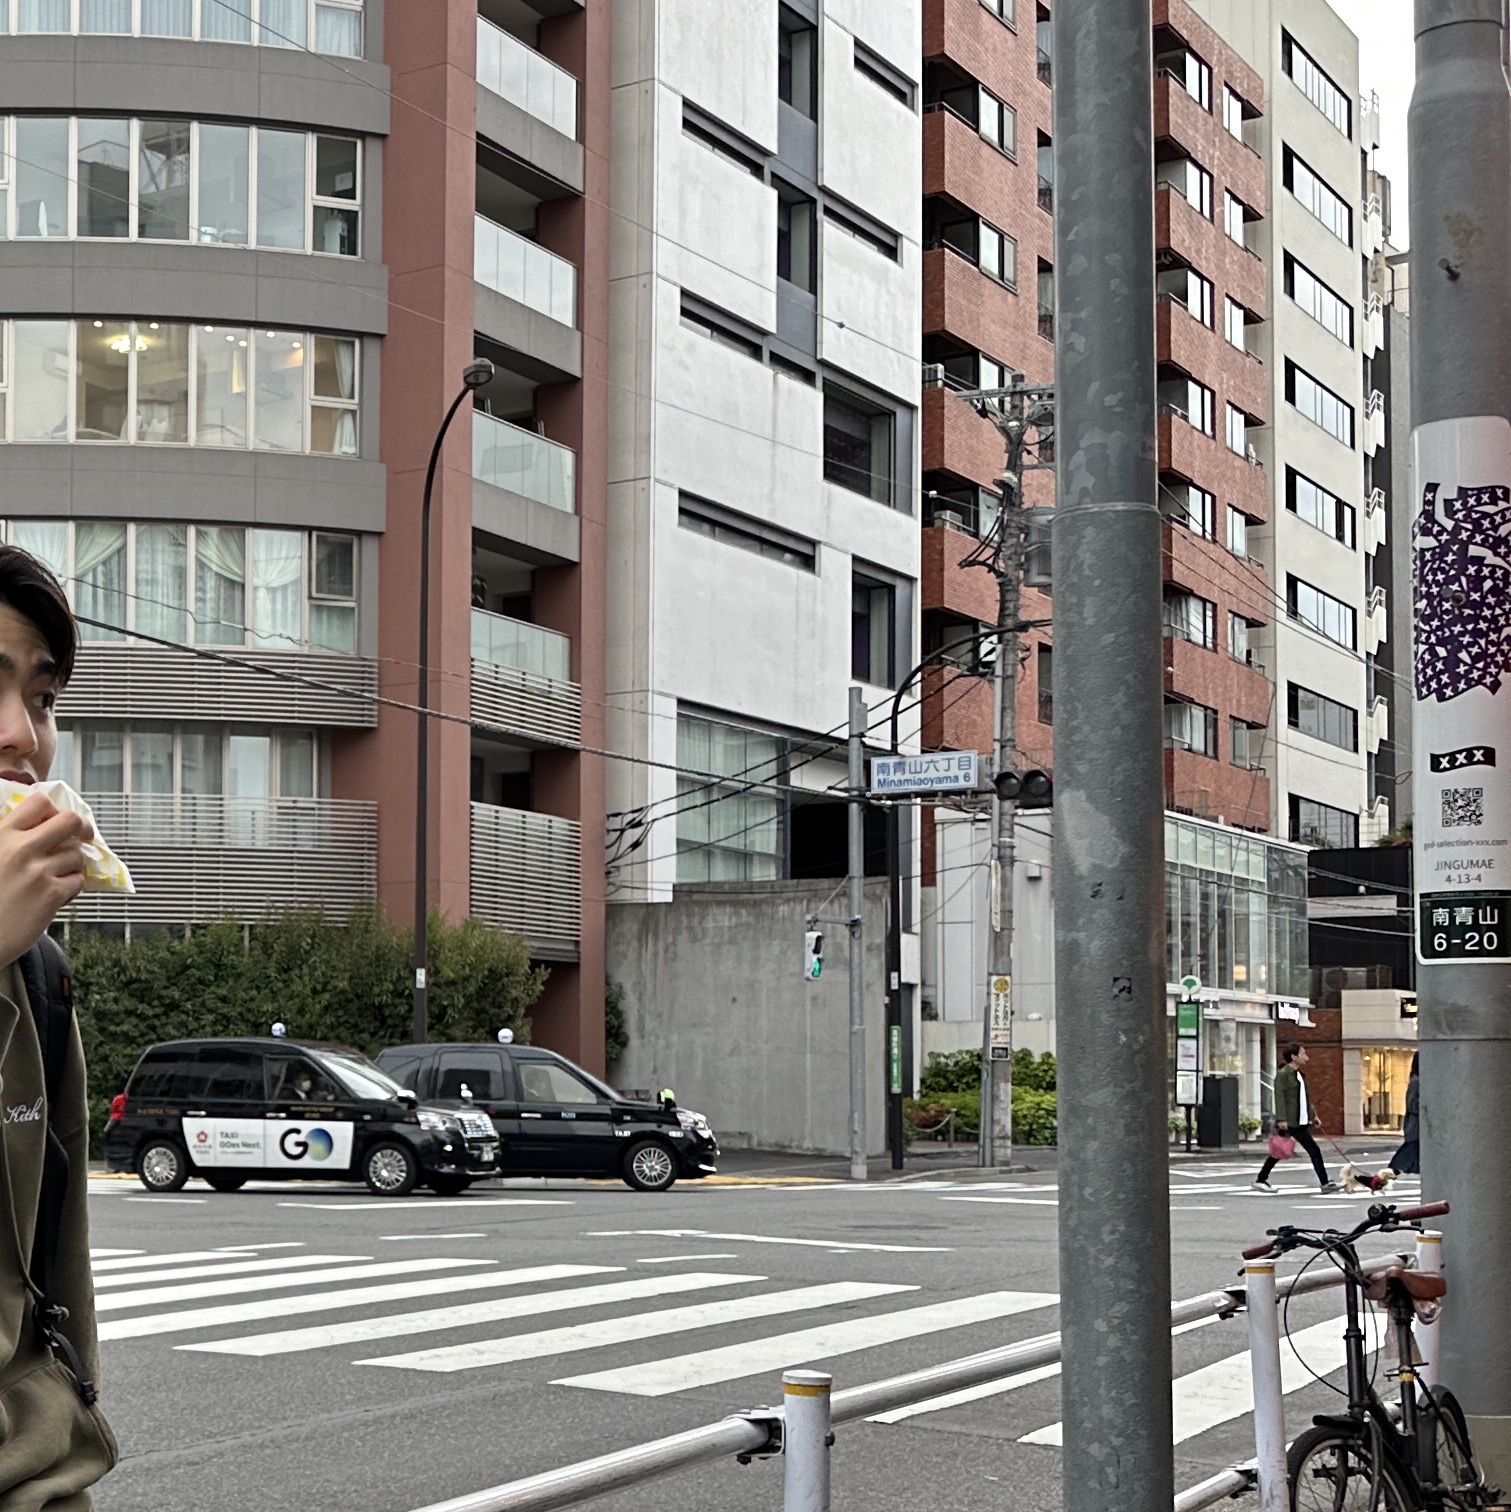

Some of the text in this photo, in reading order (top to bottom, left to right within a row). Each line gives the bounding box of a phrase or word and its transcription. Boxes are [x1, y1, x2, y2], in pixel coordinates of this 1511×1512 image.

[876, 755, 972, 776] 南青山六丁目
[877, 771, 971, 789] Minamiaoyama 6
[1434, 858, 1495, 872] JINGUMAE
[1444, 873, 1482, 884] 4-13-4
[1431, 905, 1499, 927] 南青山
[1433, 931, 1499, 952] 6-20
[3, 1096, 44, 1124] Kith
[279, 1127, 334, 1162] GO
